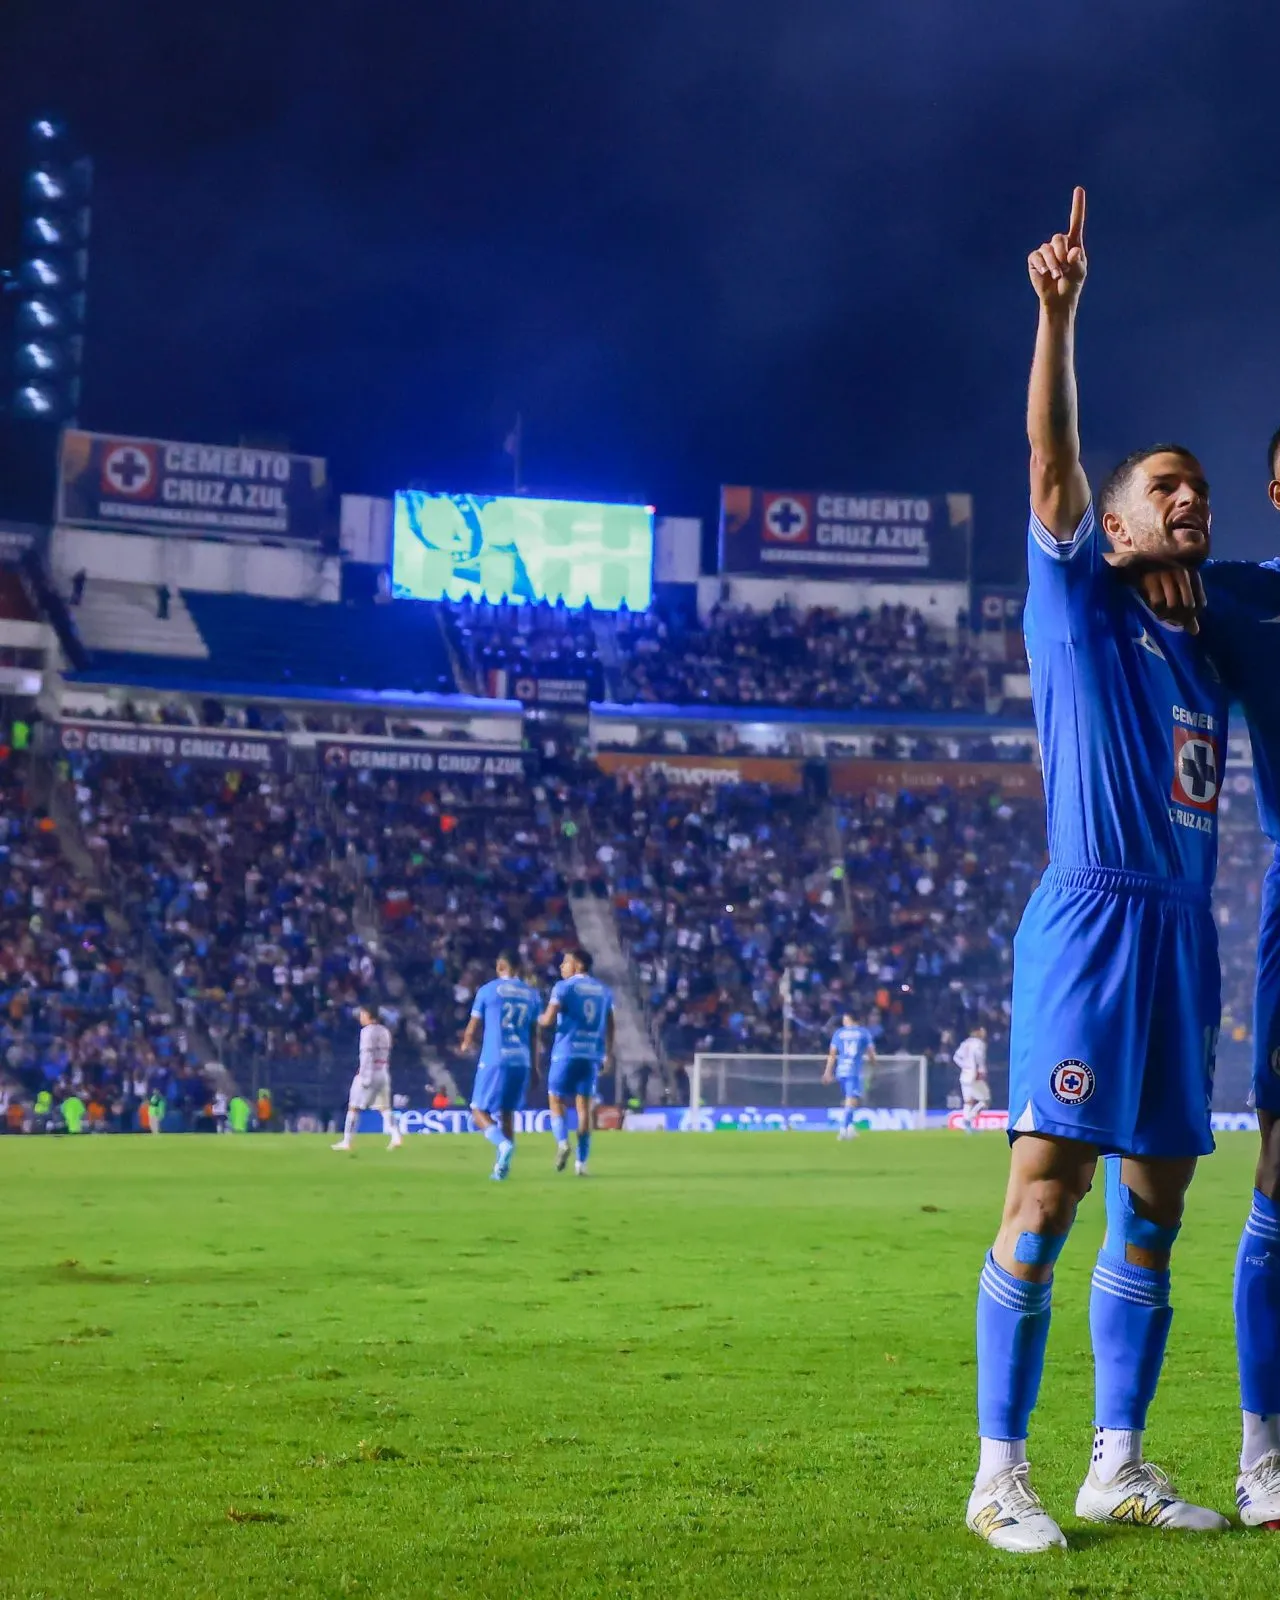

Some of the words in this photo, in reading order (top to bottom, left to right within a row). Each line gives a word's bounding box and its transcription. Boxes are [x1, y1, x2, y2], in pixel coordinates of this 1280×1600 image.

[164, 445, 290, 481] CEMENTO
[162, 478, 225, 506] CRUZ
[228, 483, 287, 510] AZUL
[816, 495, 931, 522] CEMENTO
[815, 523, 873, 547] CRUZ
[875, 525, 929, 549] AZUL
[86, 731, 176, 755] CEMENTO
[180, 736, 226, 758] CRUZ
[227, 742, 272, 764] AZUL
[350, 749, 434, 771] CEMENTO
[437, 754, 482, 775] CRUZ
[483, 757, 525, 776] AZUL
[1168, 806, 1195, 829] CRUZ
[501, 1001, 529, 1029] 27
[583, 998, 597, 1025] 9
